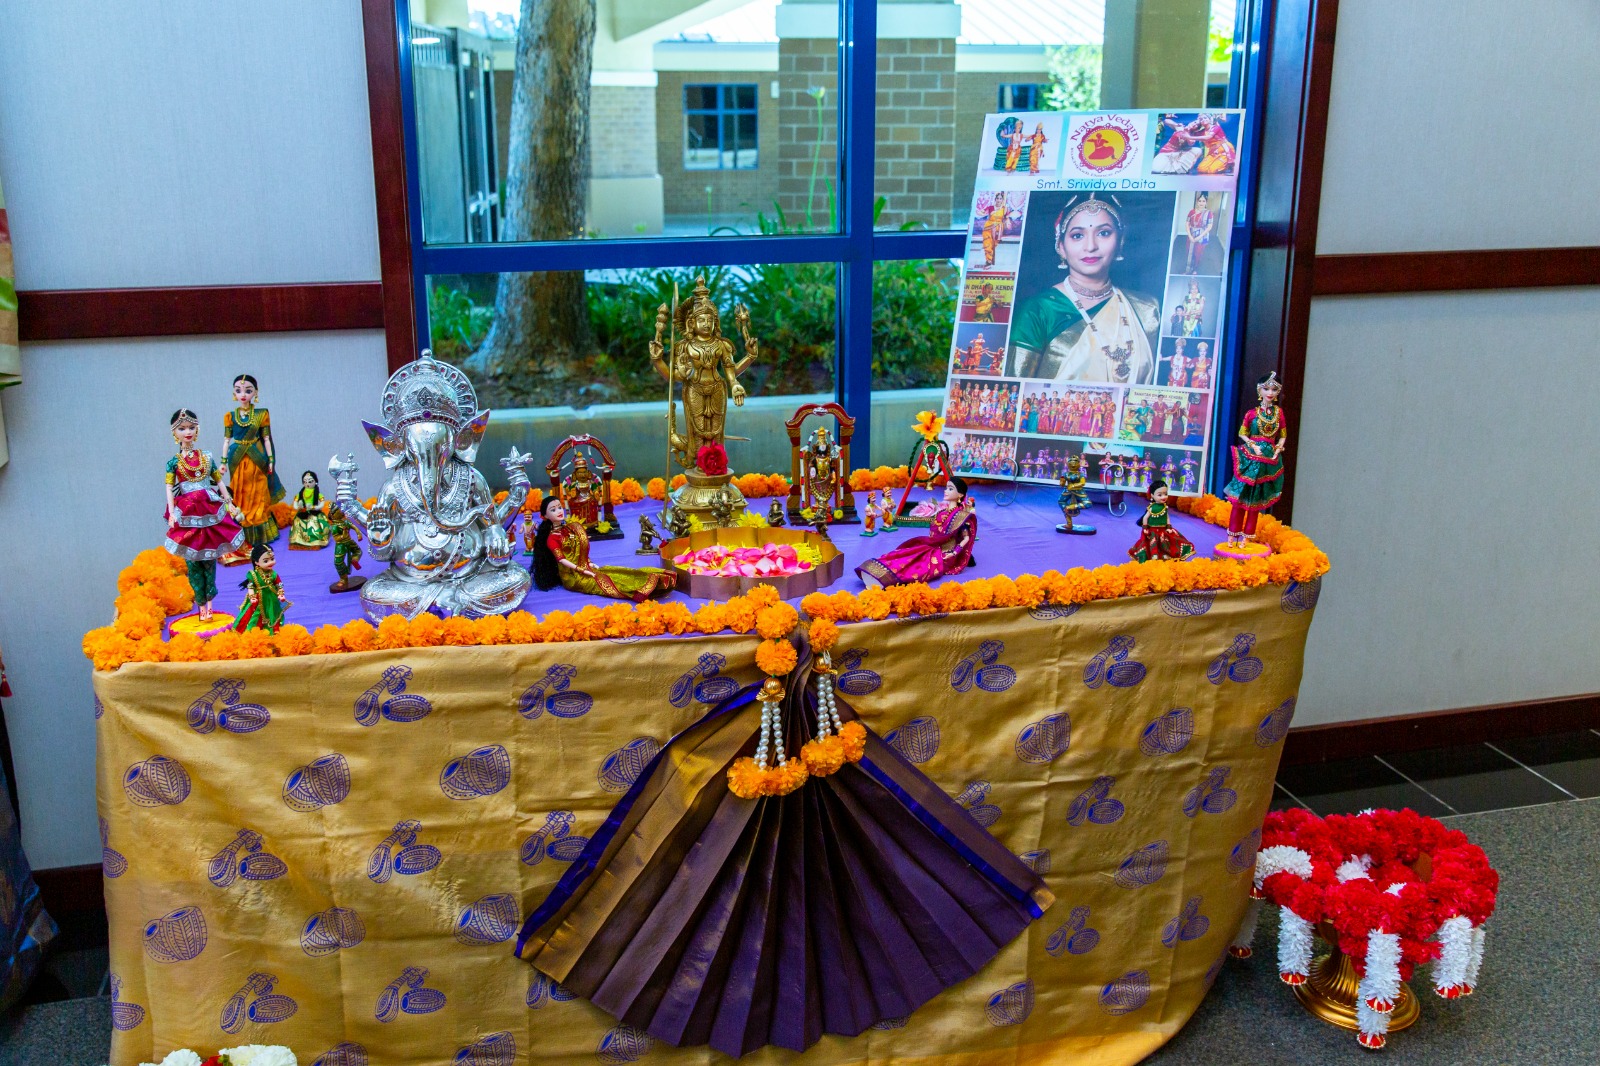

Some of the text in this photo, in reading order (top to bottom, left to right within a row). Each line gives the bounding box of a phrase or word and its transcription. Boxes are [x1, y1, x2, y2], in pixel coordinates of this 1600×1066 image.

[1070, 114, 1139, 141] Natya Vedam
[1036, 178, 1156, 191] Smt. Srividya Daita
